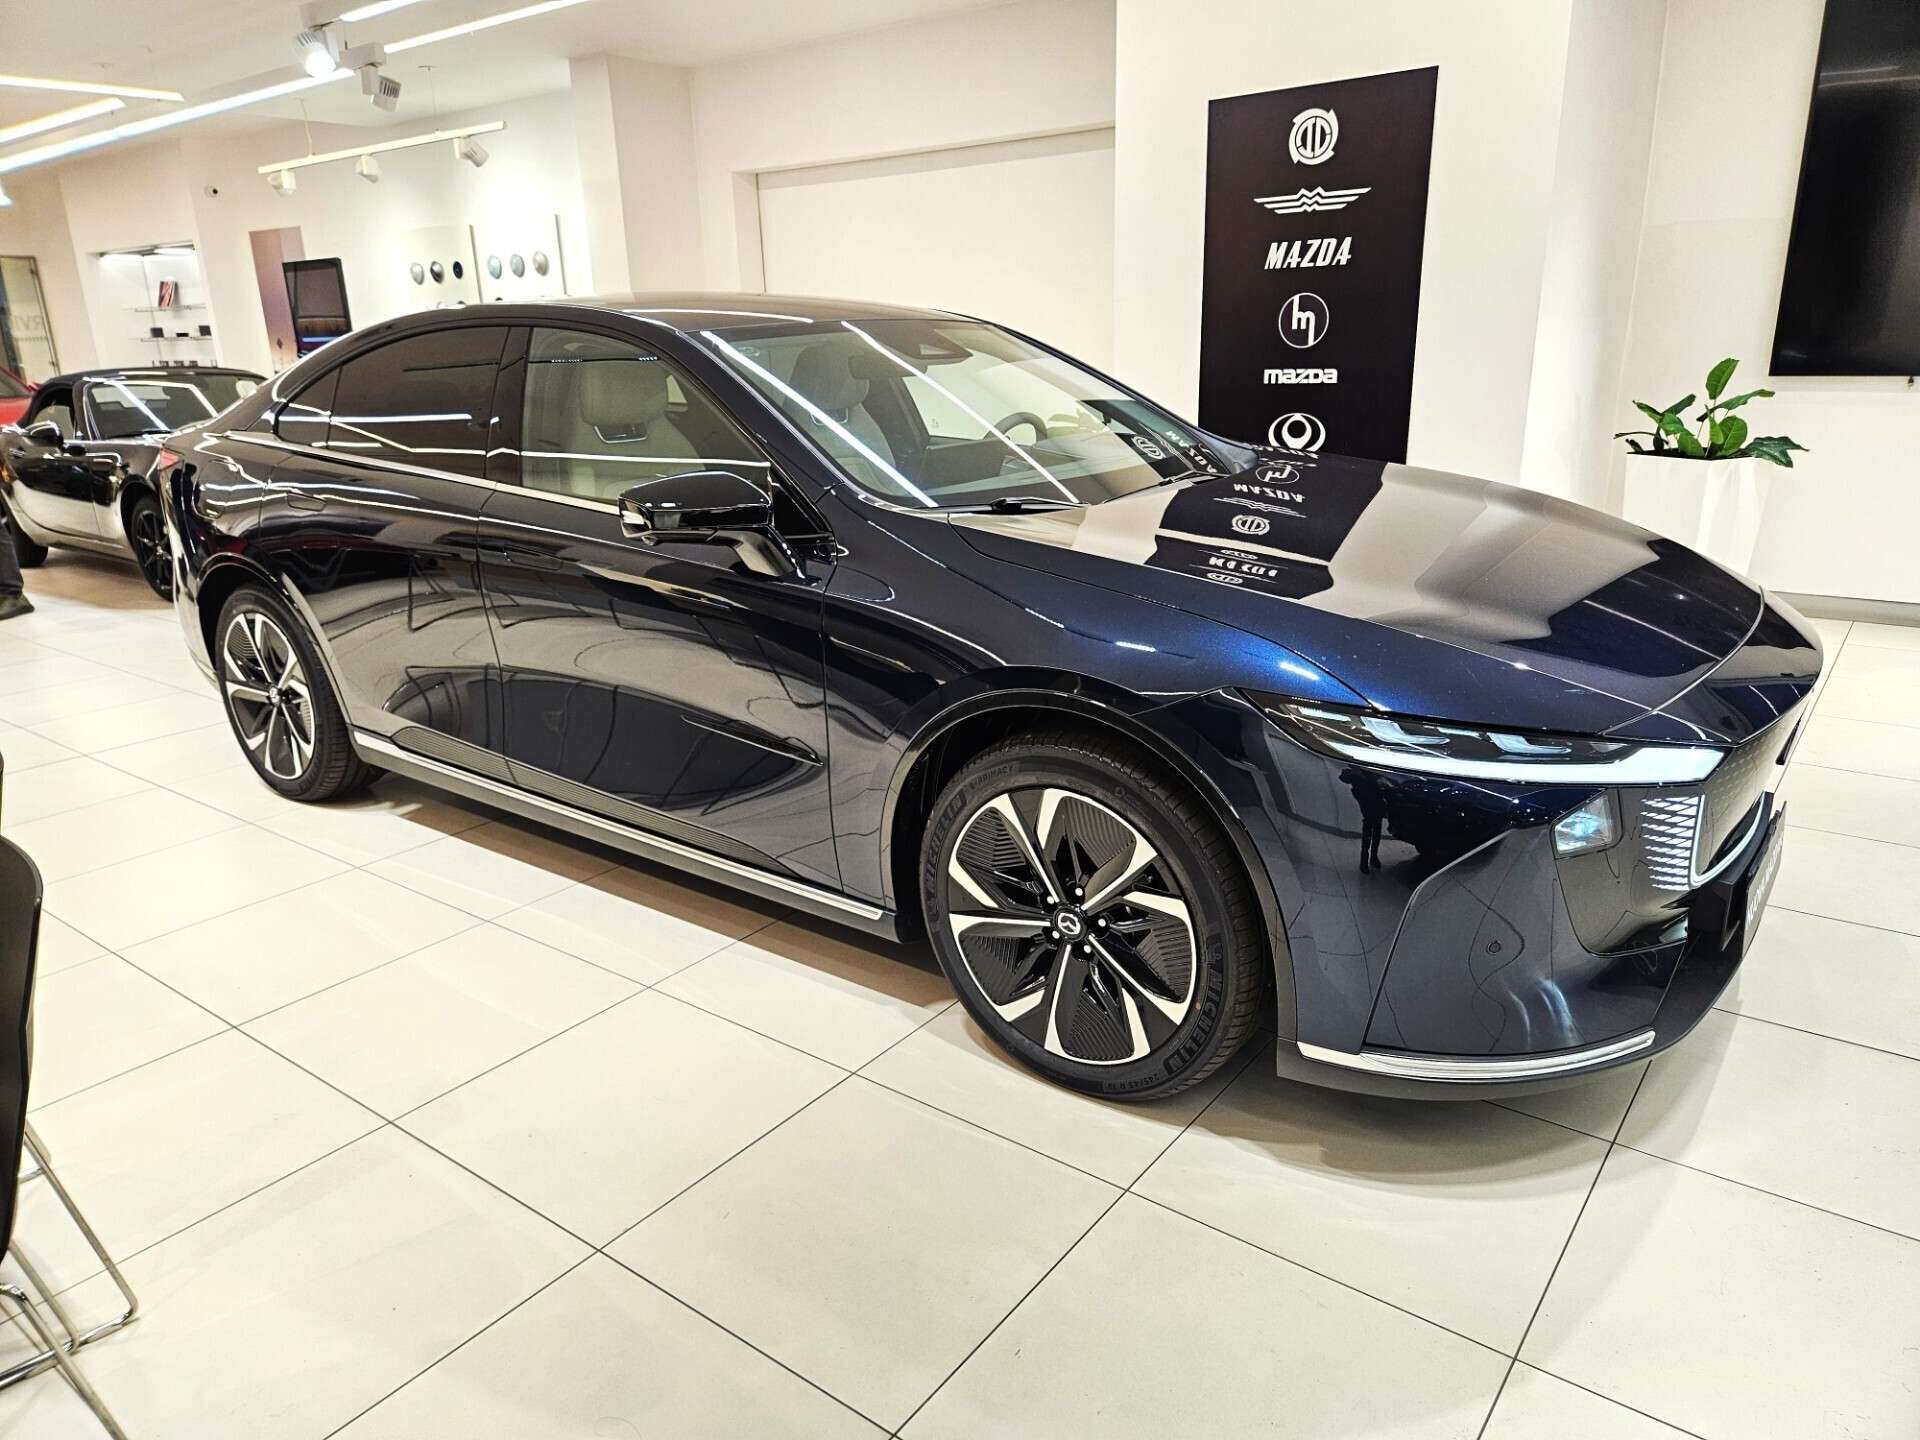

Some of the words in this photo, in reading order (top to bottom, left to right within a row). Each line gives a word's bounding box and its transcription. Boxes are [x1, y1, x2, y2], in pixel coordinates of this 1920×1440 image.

[1264, 237, 1352, 269] MAZDA
[1264, 368, 1338, 384] mazda
[1168, 966, 1223, 1072] MICHELIN
